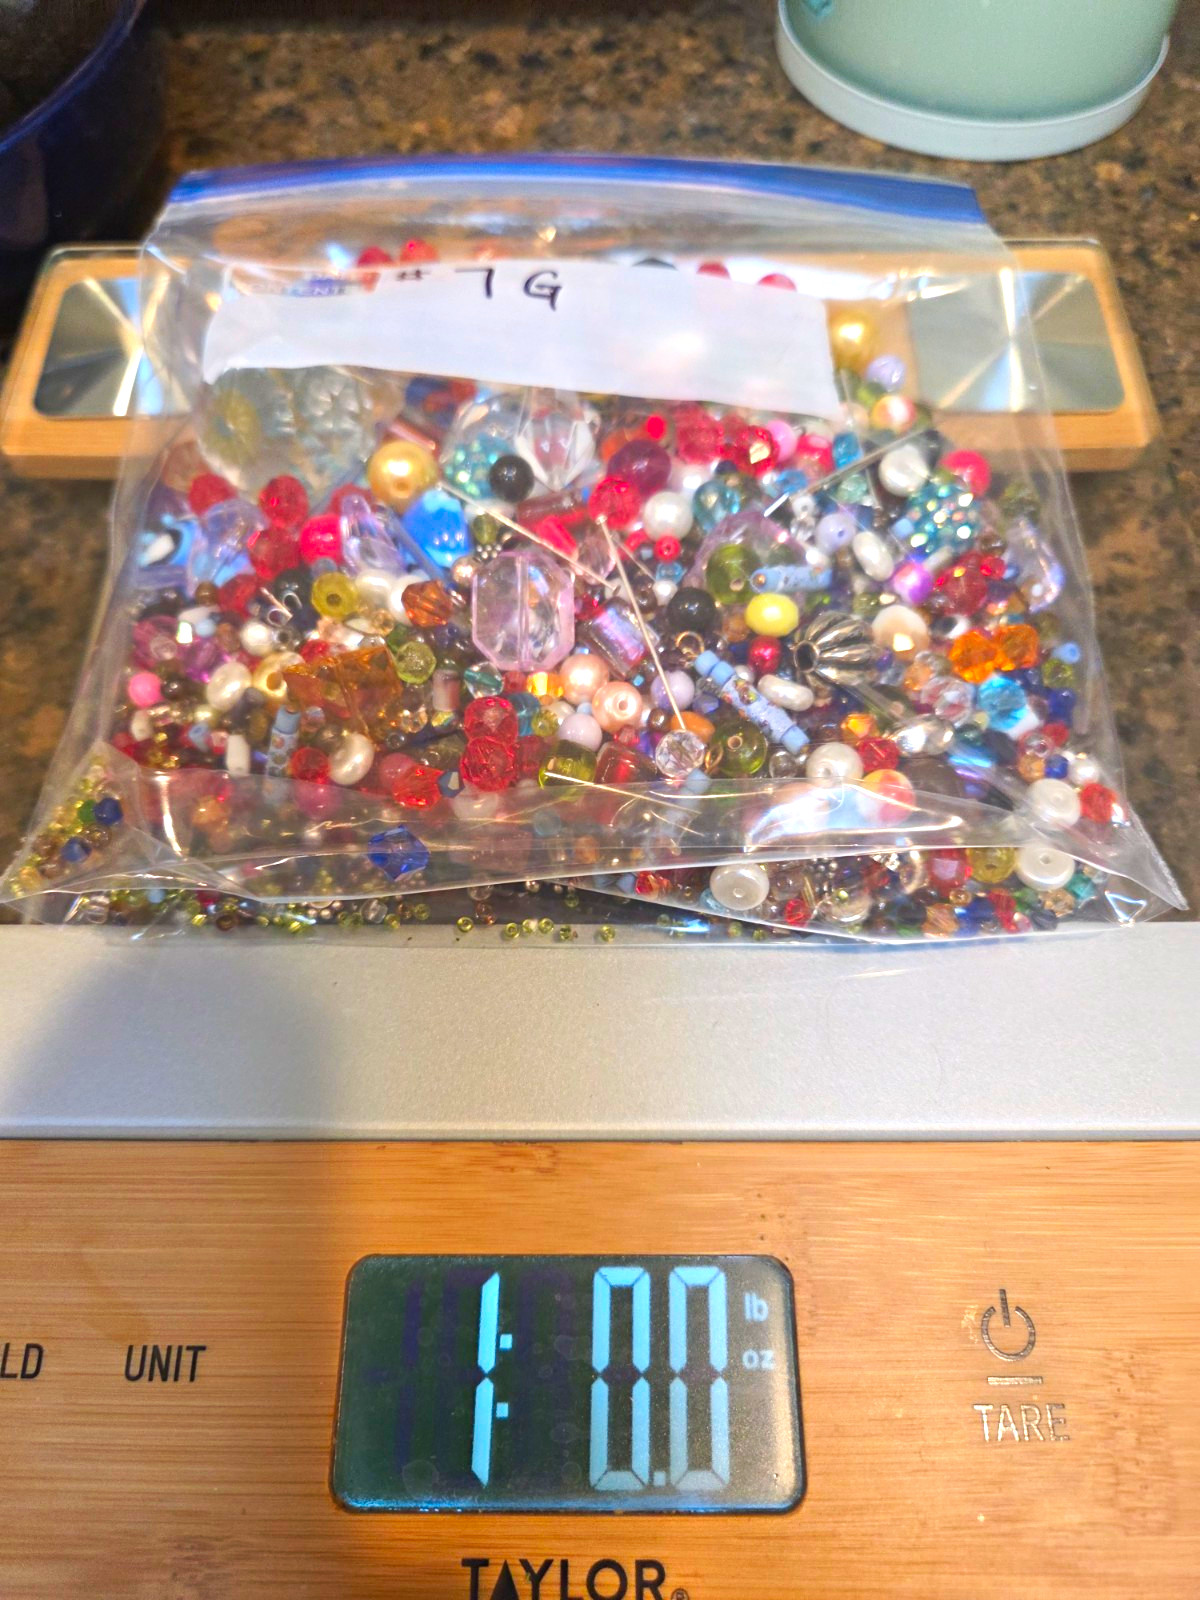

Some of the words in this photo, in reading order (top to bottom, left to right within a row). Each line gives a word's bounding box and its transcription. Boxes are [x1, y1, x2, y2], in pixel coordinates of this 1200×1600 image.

[744, 1291, 768, 1321] lb
[124, 1345, 207, 1382] UNIT
[742, 1349, 774, 1369] oz
[973, 1403, 1070, 1442] TARE
[461, 1558, 666, 1600] TAYLOR
